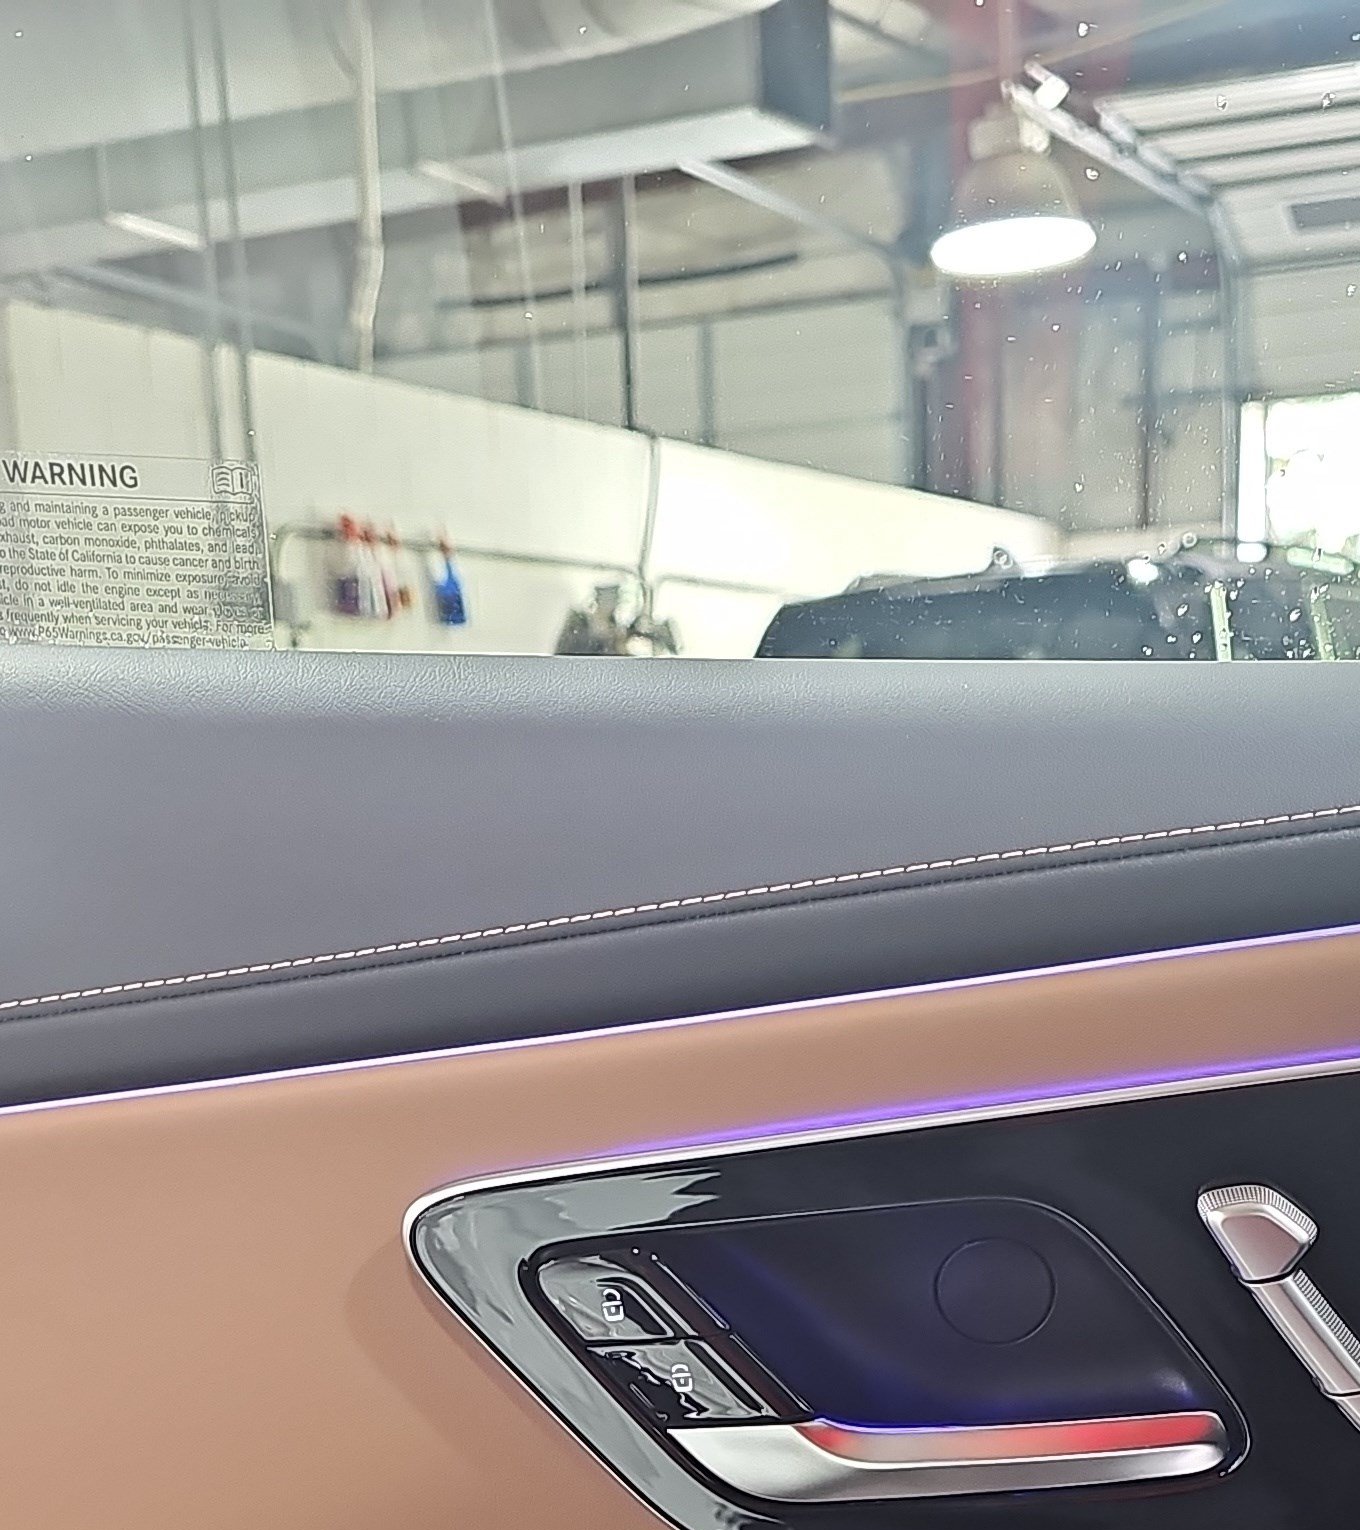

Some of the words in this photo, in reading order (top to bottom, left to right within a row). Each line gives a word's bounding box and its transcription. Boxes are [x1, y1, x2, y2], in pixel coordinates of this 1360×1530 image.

[2, 459, 139, 489] WARNING
[10, 500, 30, 512] and
[34, 501, 98, 517] maintaining
[102, 505, 109, 516] a
[113, 506, 170, 521] passenger
[173, 507, 215, 523] vehicle,
[19, 517, 51, 529] motor
[54, 518, 93, 531] vehicle
[96, 521, 117, 532] can
[121, 523, 160, 537] expose
[163, 525, 183, 537] you
[186, 524, 198, 536] to
[202, 525, 257, 539] chemicals
[42, 533, 80, 546] carbon
[84, 536, 141, 551] monoxide,
[144, 538, 204, 554] phthalates,
[207, 541, 228, 553] and
[8, 547, 26, 559] the
[28, 548, 57, 561] State
[58, 549, 70, 561] of
[71, 549, 123, 565] California
[125, 553, 136, 565] to
[138, 555, 170, 567] cause
[172, 556, 208, 569] cancer
[211, 558, 232, 571] and
[234, 558, 260, 571] birth
[70, 565, 102, 579] harm.
[105, 567, 119, 580] To
[123, 568, 171, 583] minimize
[14, 578, 30, 592] do
[34, 579, 52, 592] not
[56, 580, 77, 594] idle
[81, 582, 99, 595] the
[104, 584, 141, 599] engine
[145, 587, 181, 601] except
[186, 589, 200, 600] as
[38, 597, 45, 608] a
[49, 597, 126, 613] well-ventilated
[130, 601, 153, 613] area
[158, 601, 178, 614] and
[182, 604, 209, 616] wear
[6, 609, 63, 625] frequently
[64, 612, 91, 625] when
[94, 614, 142, 630] servicing
[145, 617, 168, 631] your
[216, 620, 233, 632] For
[237, 621, 266, 635] more
